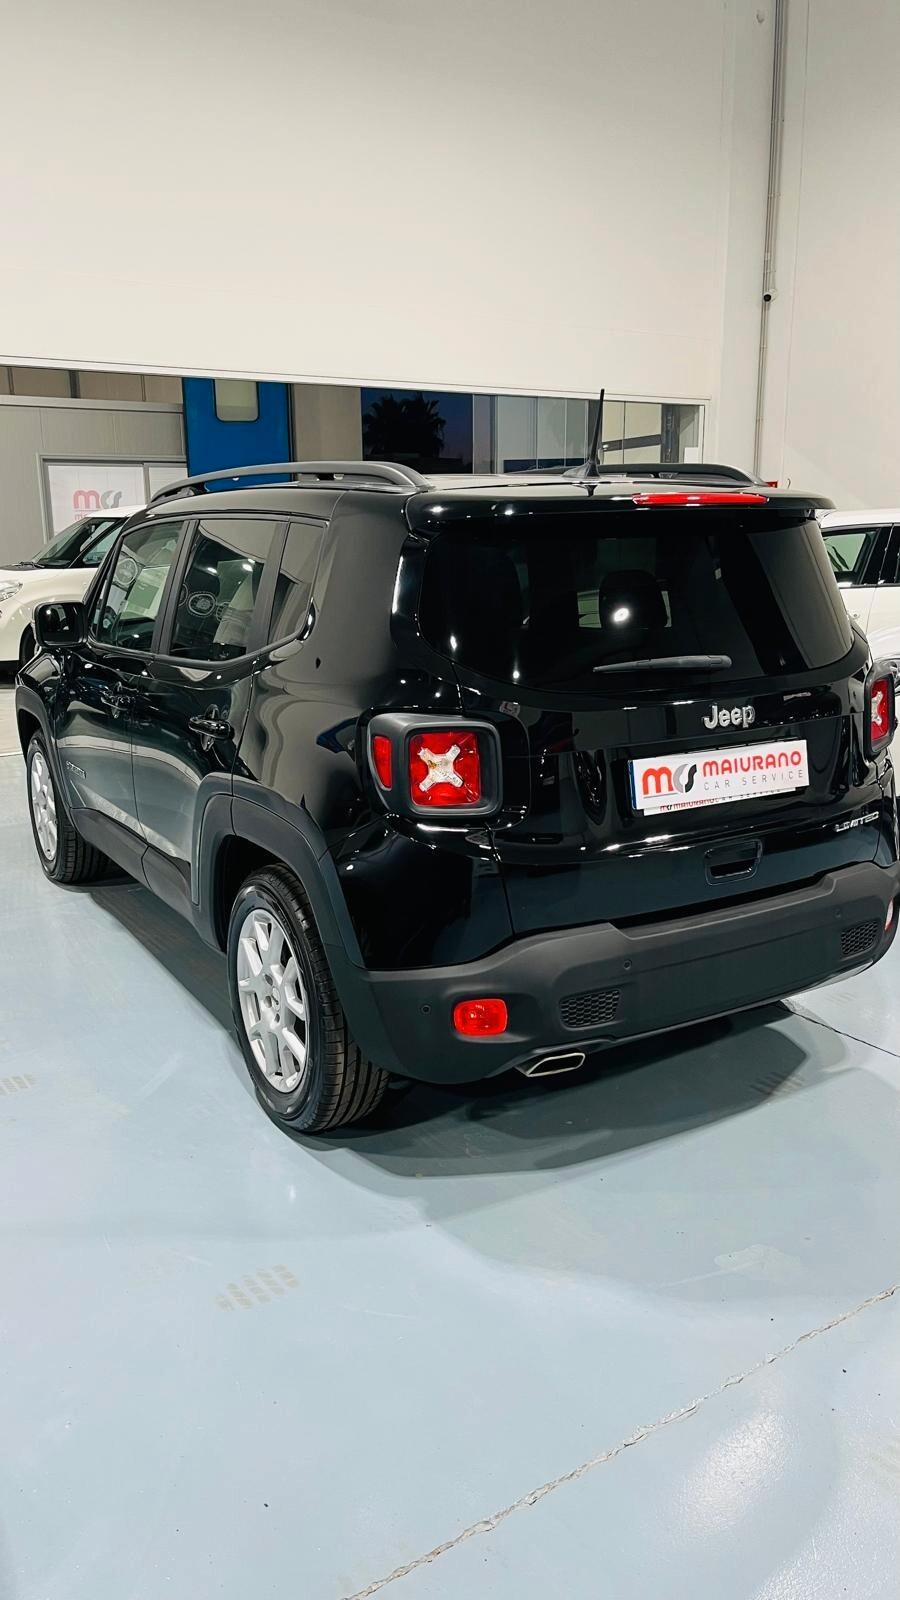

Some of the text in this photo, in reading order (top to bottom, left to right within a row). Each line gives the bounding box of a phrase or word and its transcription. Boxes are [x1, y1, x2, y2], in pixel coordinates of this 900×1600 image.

[702, 703, 756, 729] Jeep
[703, 750, 802, 777] MAIURANO
[703, 769, 804, 791] CAR SERVICE
